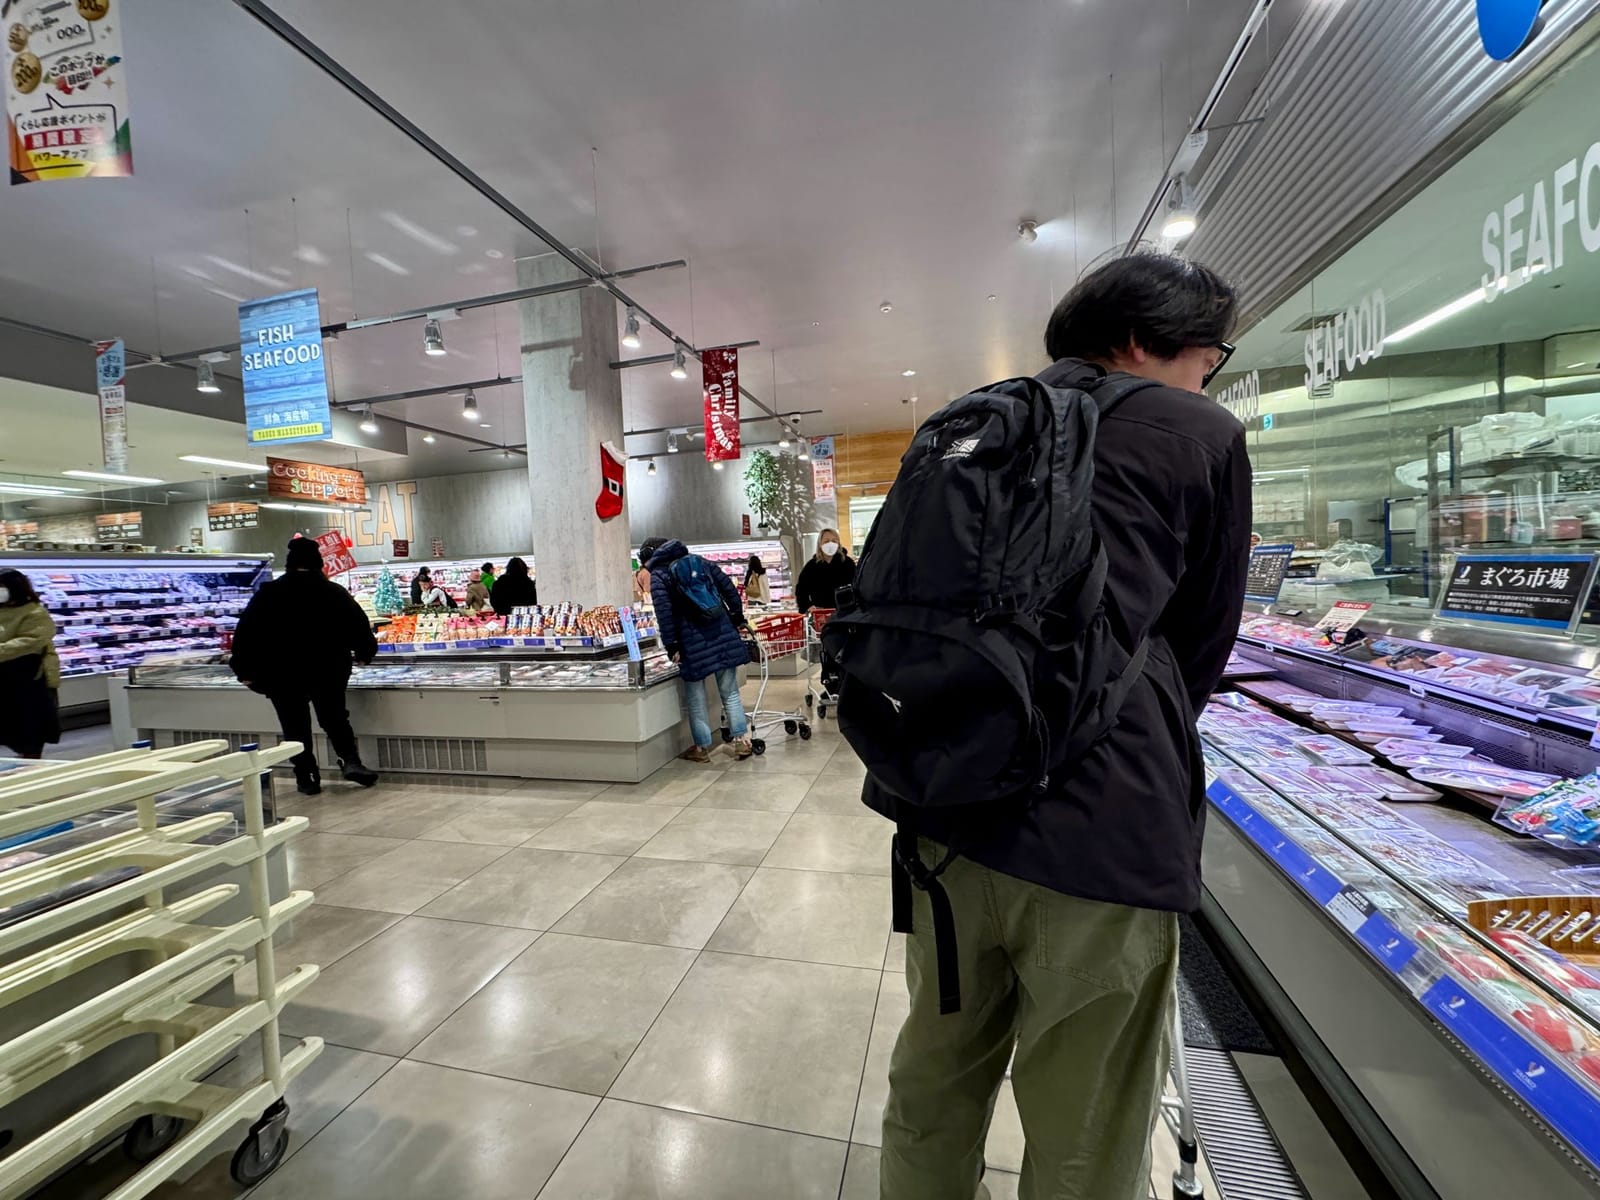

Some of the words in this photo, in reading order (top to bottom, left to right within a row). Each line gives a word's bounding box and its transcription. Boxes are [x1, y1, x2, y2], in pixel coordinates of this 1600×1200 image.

[258, 324, 294, 347] FISH
[1304, 287, 1386, 393] SEAFOOD
[244, 343, 320, 371] SEAFOOD
[721, 371, 737, 421] Family
[708, 383, 734, 451] Christmas
[272, 462, 338, 485] Cooking
[290, 478, 361, 500] Support
[1480, 566, 1570, 590] まぐろ市場
